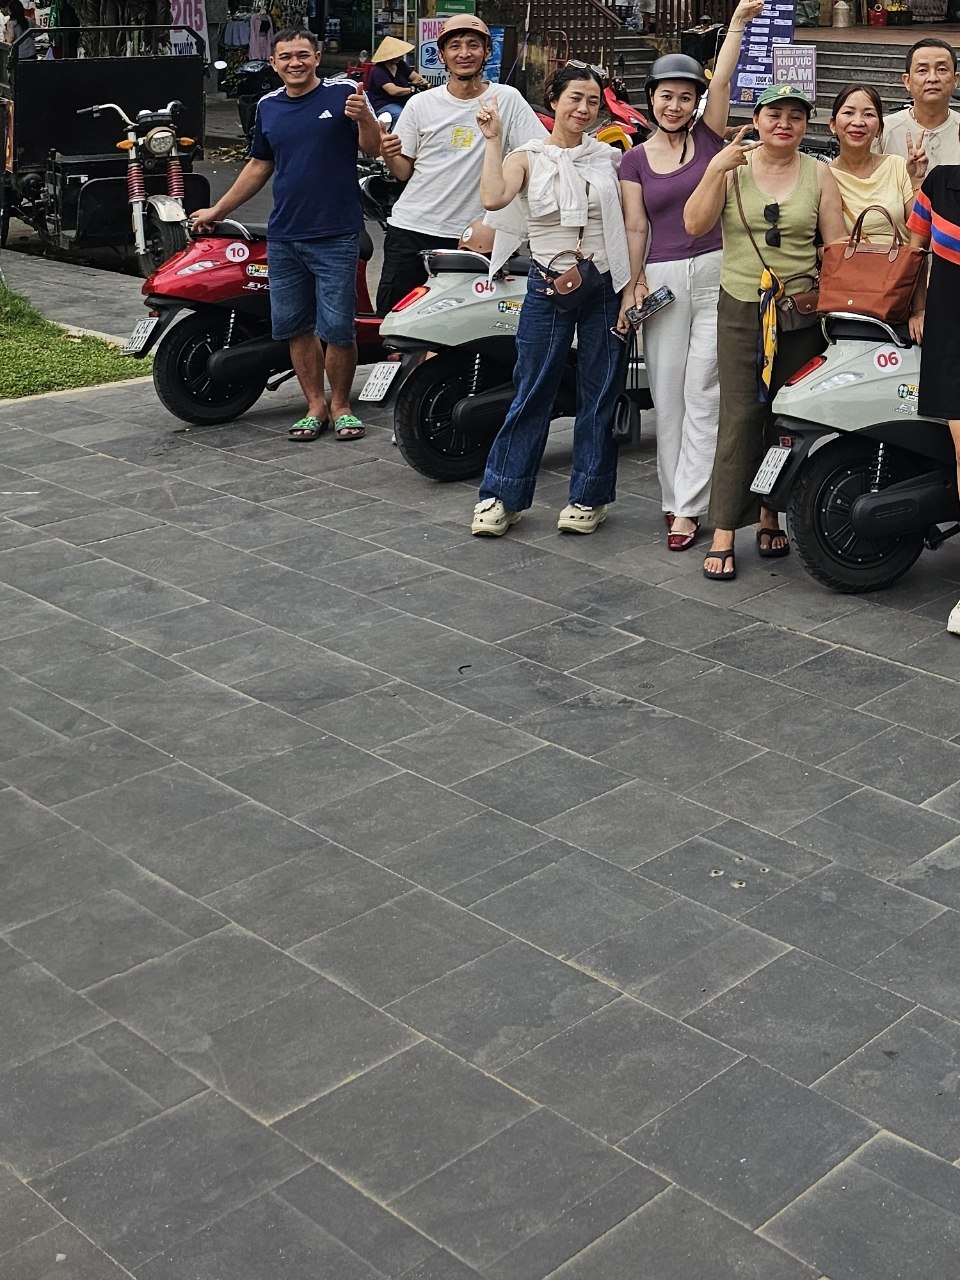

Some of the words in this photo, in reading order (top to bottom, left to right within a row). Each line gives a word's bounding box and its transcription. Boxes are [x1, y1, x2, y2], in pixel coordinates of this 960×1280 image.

[777, 57, 794, 66] KHU
[795, 55, 812, 67] VỰC
[230, 247, 246, 258] 10
[475, 280, 495, 294] 04
[877, 351, 899, 368] 06
